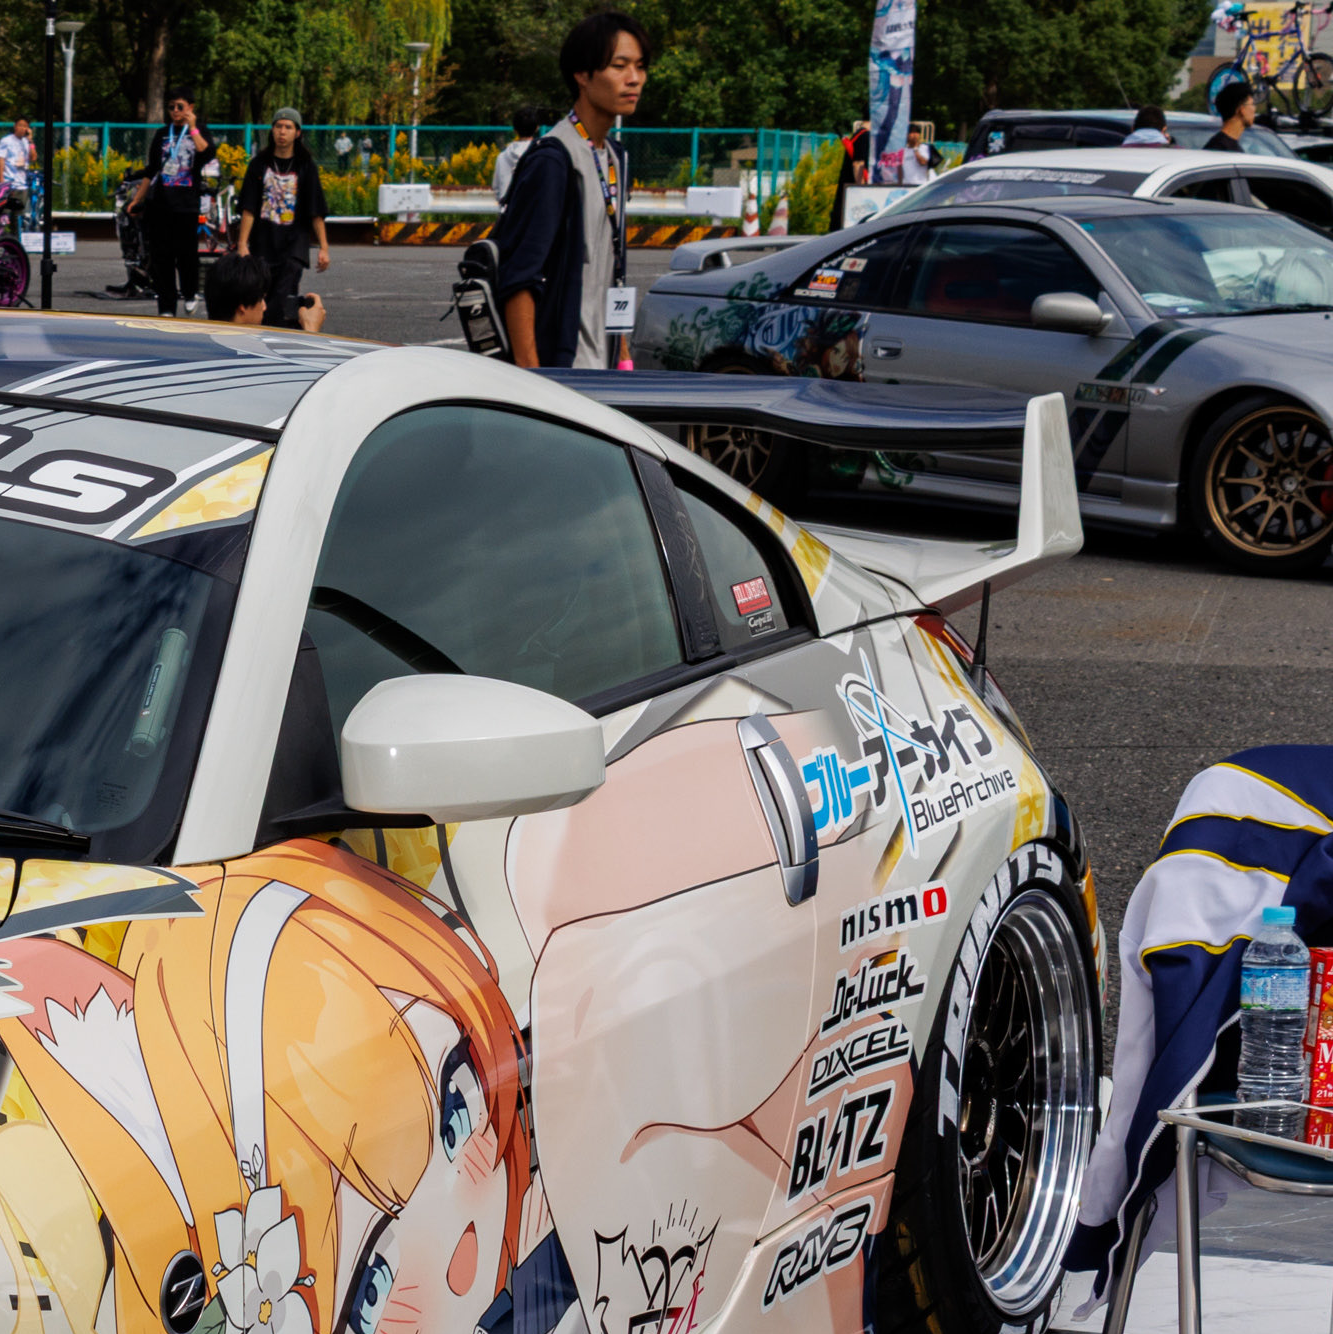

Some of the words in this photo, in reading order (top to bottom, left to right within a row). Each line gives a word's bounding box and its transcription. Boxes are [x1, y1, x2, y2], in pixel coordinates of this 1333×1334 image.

[803, 705, 992, 832] ブルーアーカイブ
[912, 768, 1015, 833] BlueArchive
[841, 887, 946, 947] nismo
[938, 842, 1063, 1136] TRINITY
[809, 1023, 910, 1098] DIXCEL
[788, 1090, 893, 1202] BLITZ
[763, 1206, 871, 1306] RAYS
